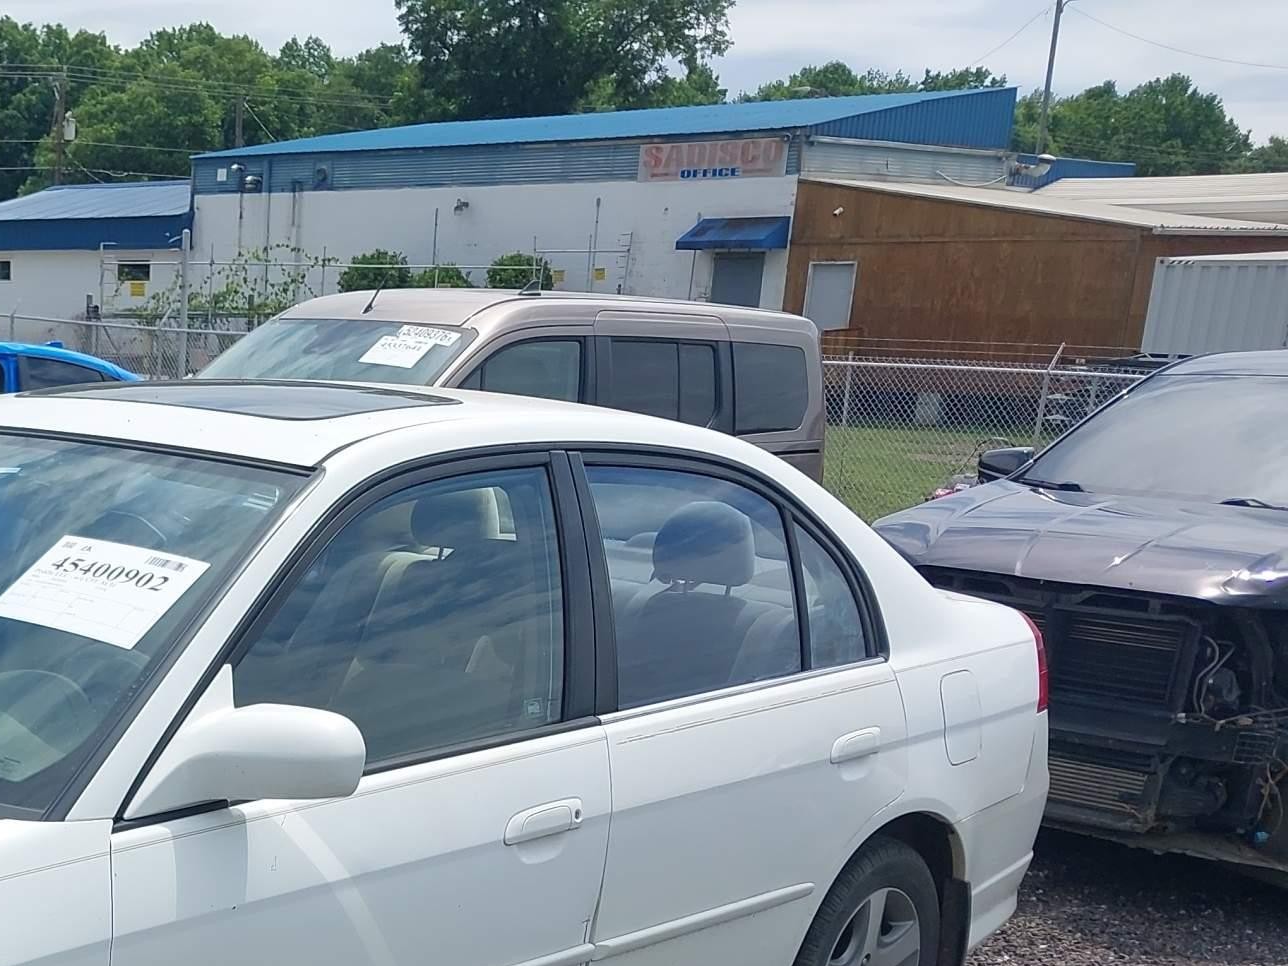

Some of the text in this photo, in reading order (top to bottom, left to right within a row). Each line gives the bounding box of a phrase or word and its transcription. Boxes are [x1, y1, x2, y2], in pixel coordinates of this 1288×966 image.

[643, 140, 785, 169] SADISCO
[680, 167, 741, 179] OFFICE
[51, 556, 170, 592] 45400902
